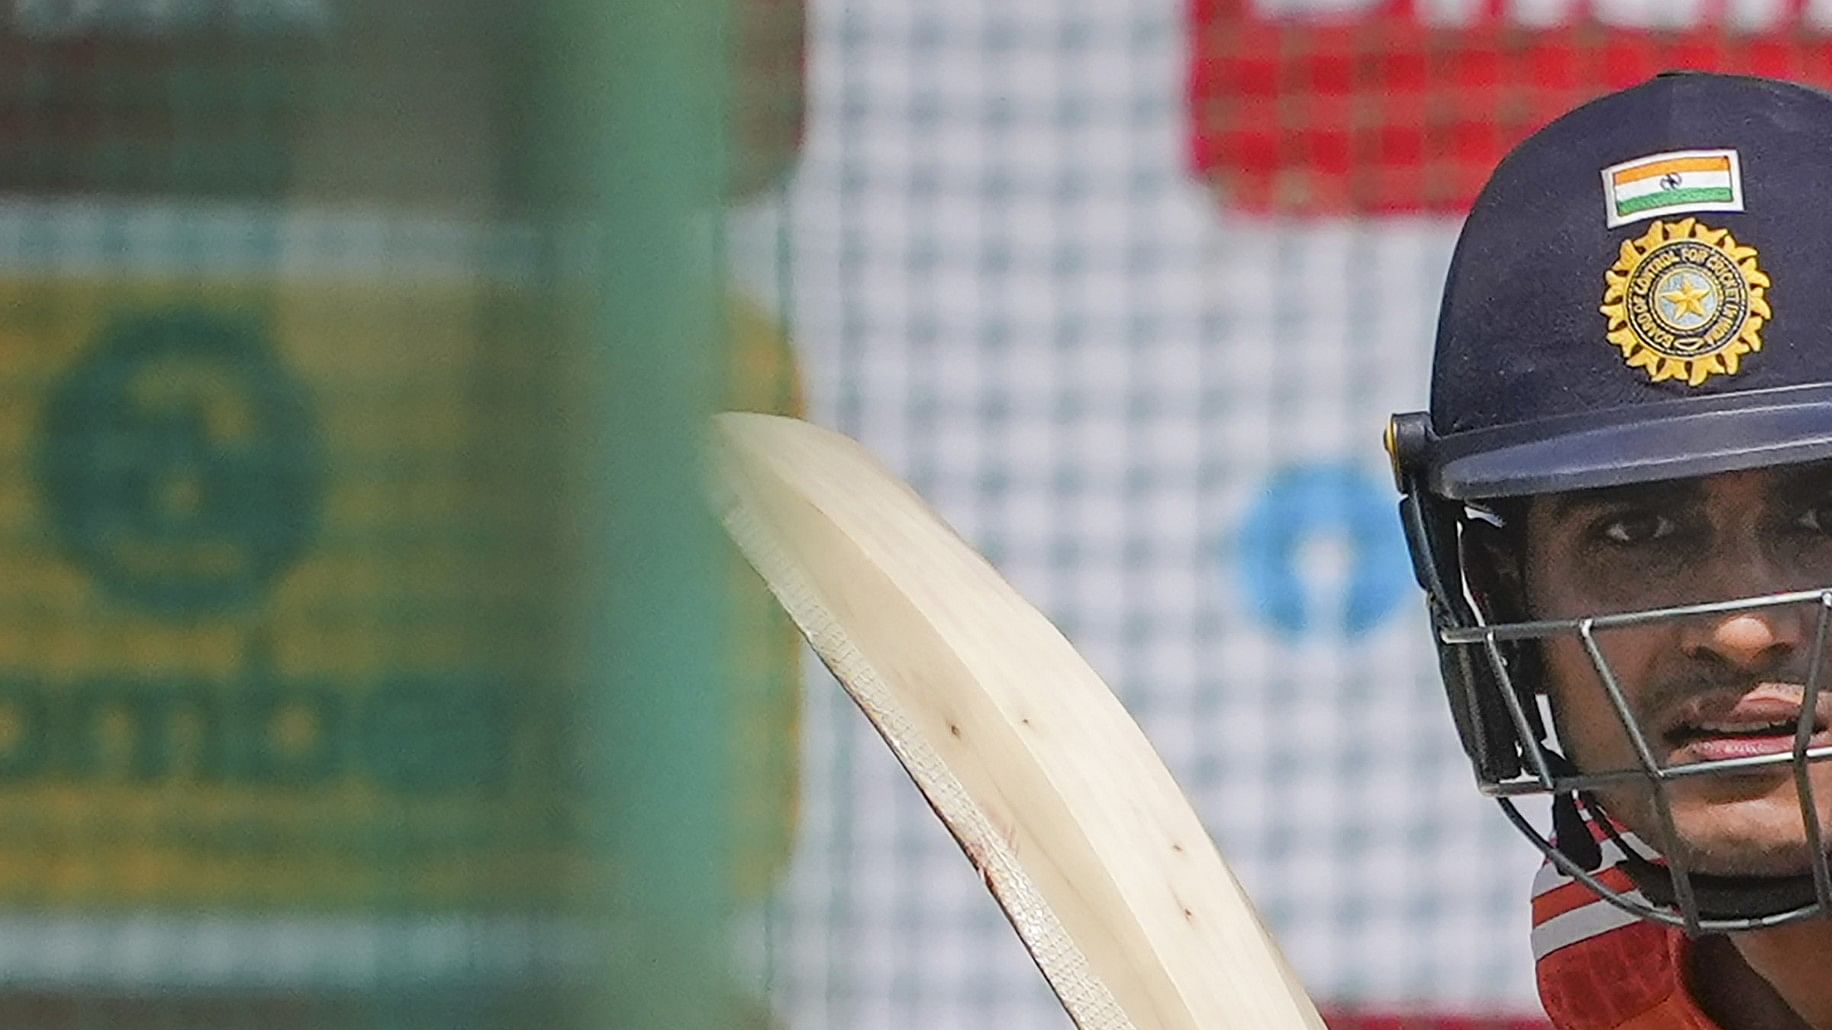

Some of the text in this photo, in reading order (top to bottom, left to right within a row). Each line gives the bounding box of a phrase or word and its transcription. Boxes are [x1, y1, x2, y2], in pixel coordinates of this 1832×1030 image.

[1634, 250, 1681, 296] CONTROL
[1680, 247, 1710, 264] FOR
[1705, 254, 1741, 304] CRICKET
[1632, 295, 1648, 314] OF
[1637, 314, 1675, 349] BOARD
